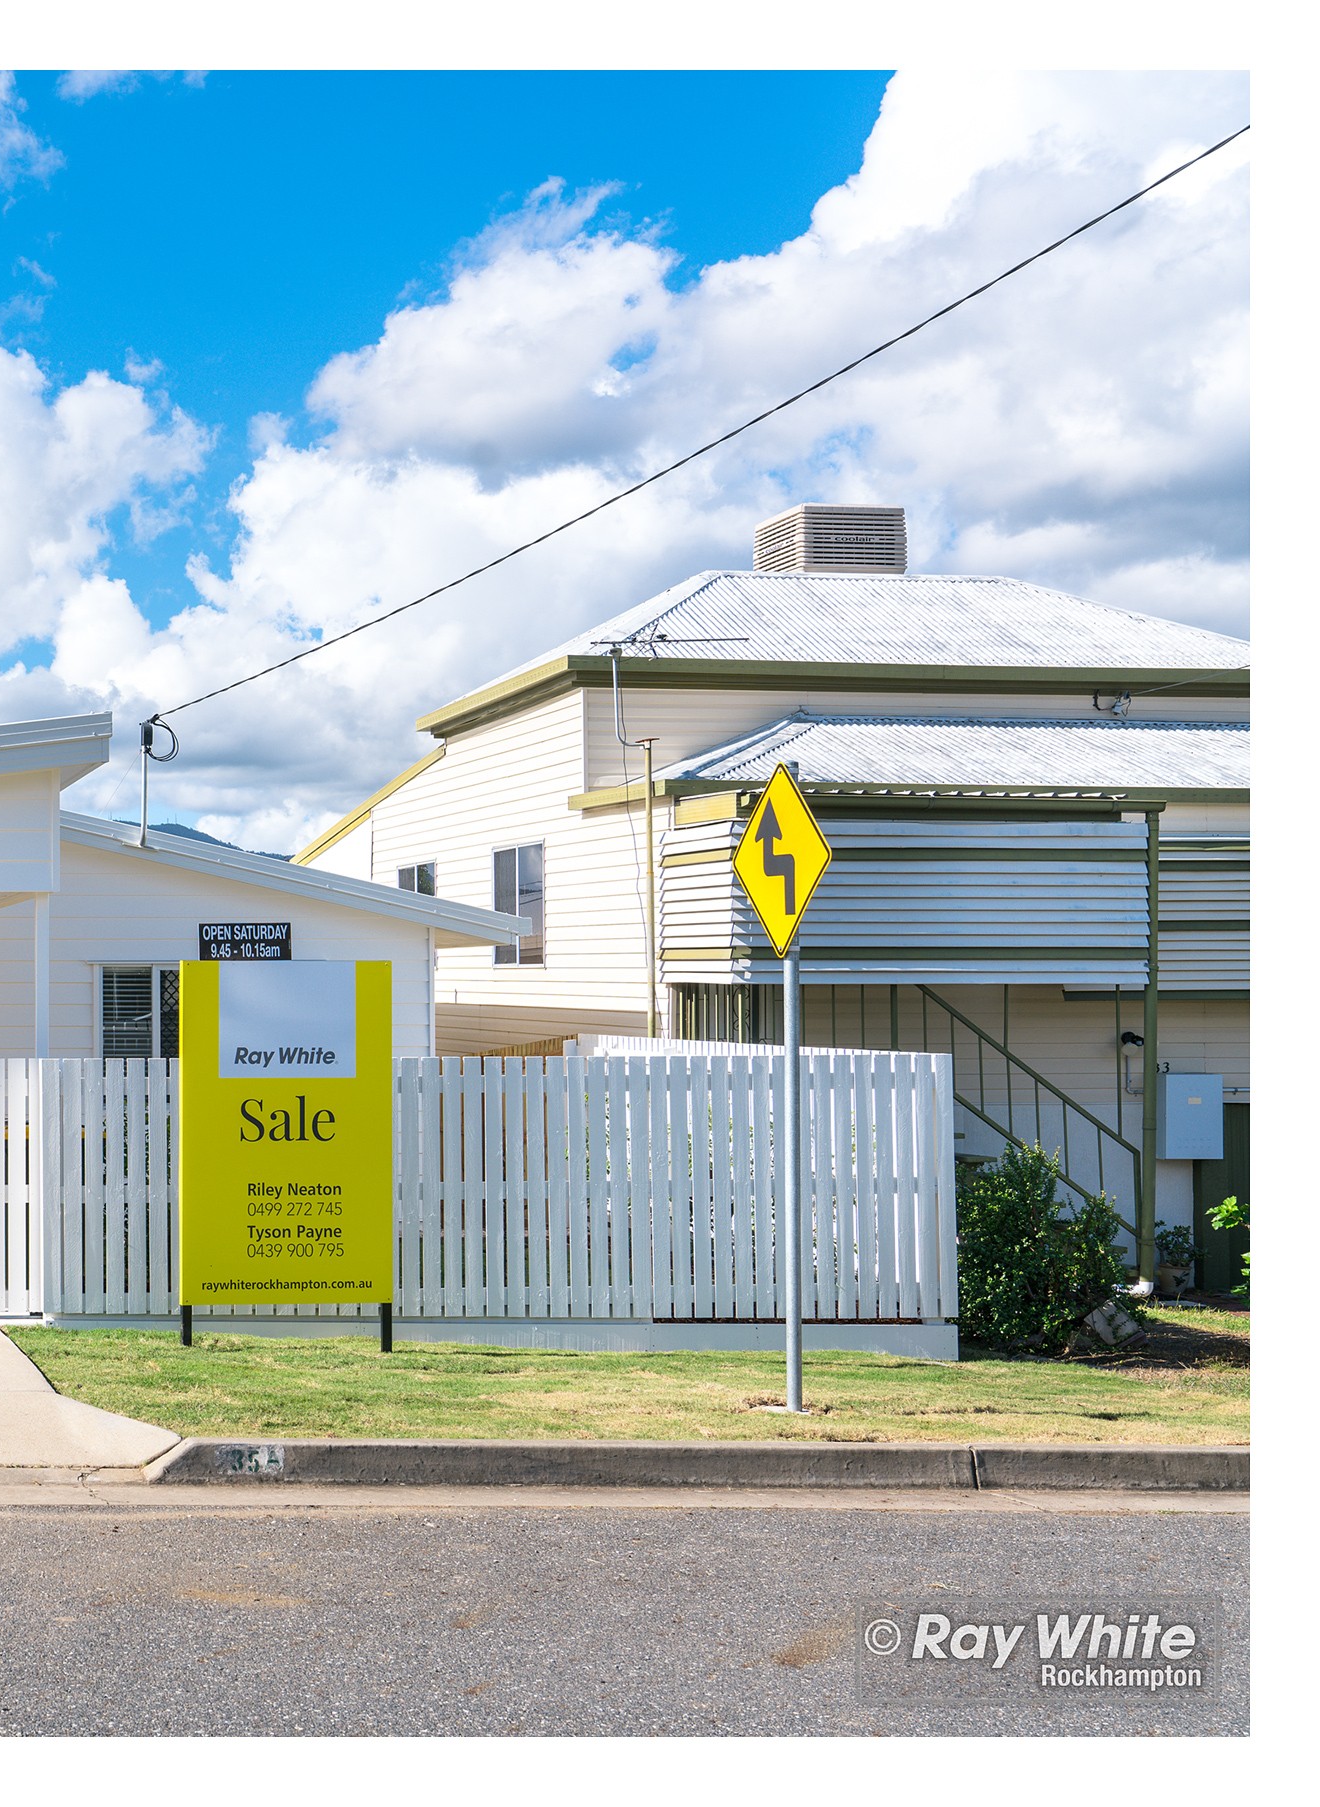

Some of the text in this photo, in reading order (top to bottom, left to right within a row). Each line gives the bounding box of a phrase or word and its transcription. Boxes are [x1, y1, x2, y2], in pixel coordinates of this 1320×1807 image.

[202, 924, 288, 941] OPEN SATURDAY
[210, 944, 231, 958] 9.45
[240, 943, 281, 958] 10.15am
[234, 1047, 336, 1068] Ray White
[240, 1095, 336, 1142] Sale
[247, 1182, 342, 1199] Riley Neaton
[247, 1202, 343, 1216] 0499 272 745
[247, 1225, 342, 1242] Tyson Payne
[247, 1243, 344, 1257] 0439 900 795
[201, 1279, 372, 1292] raywhiterockhampton.com.au
